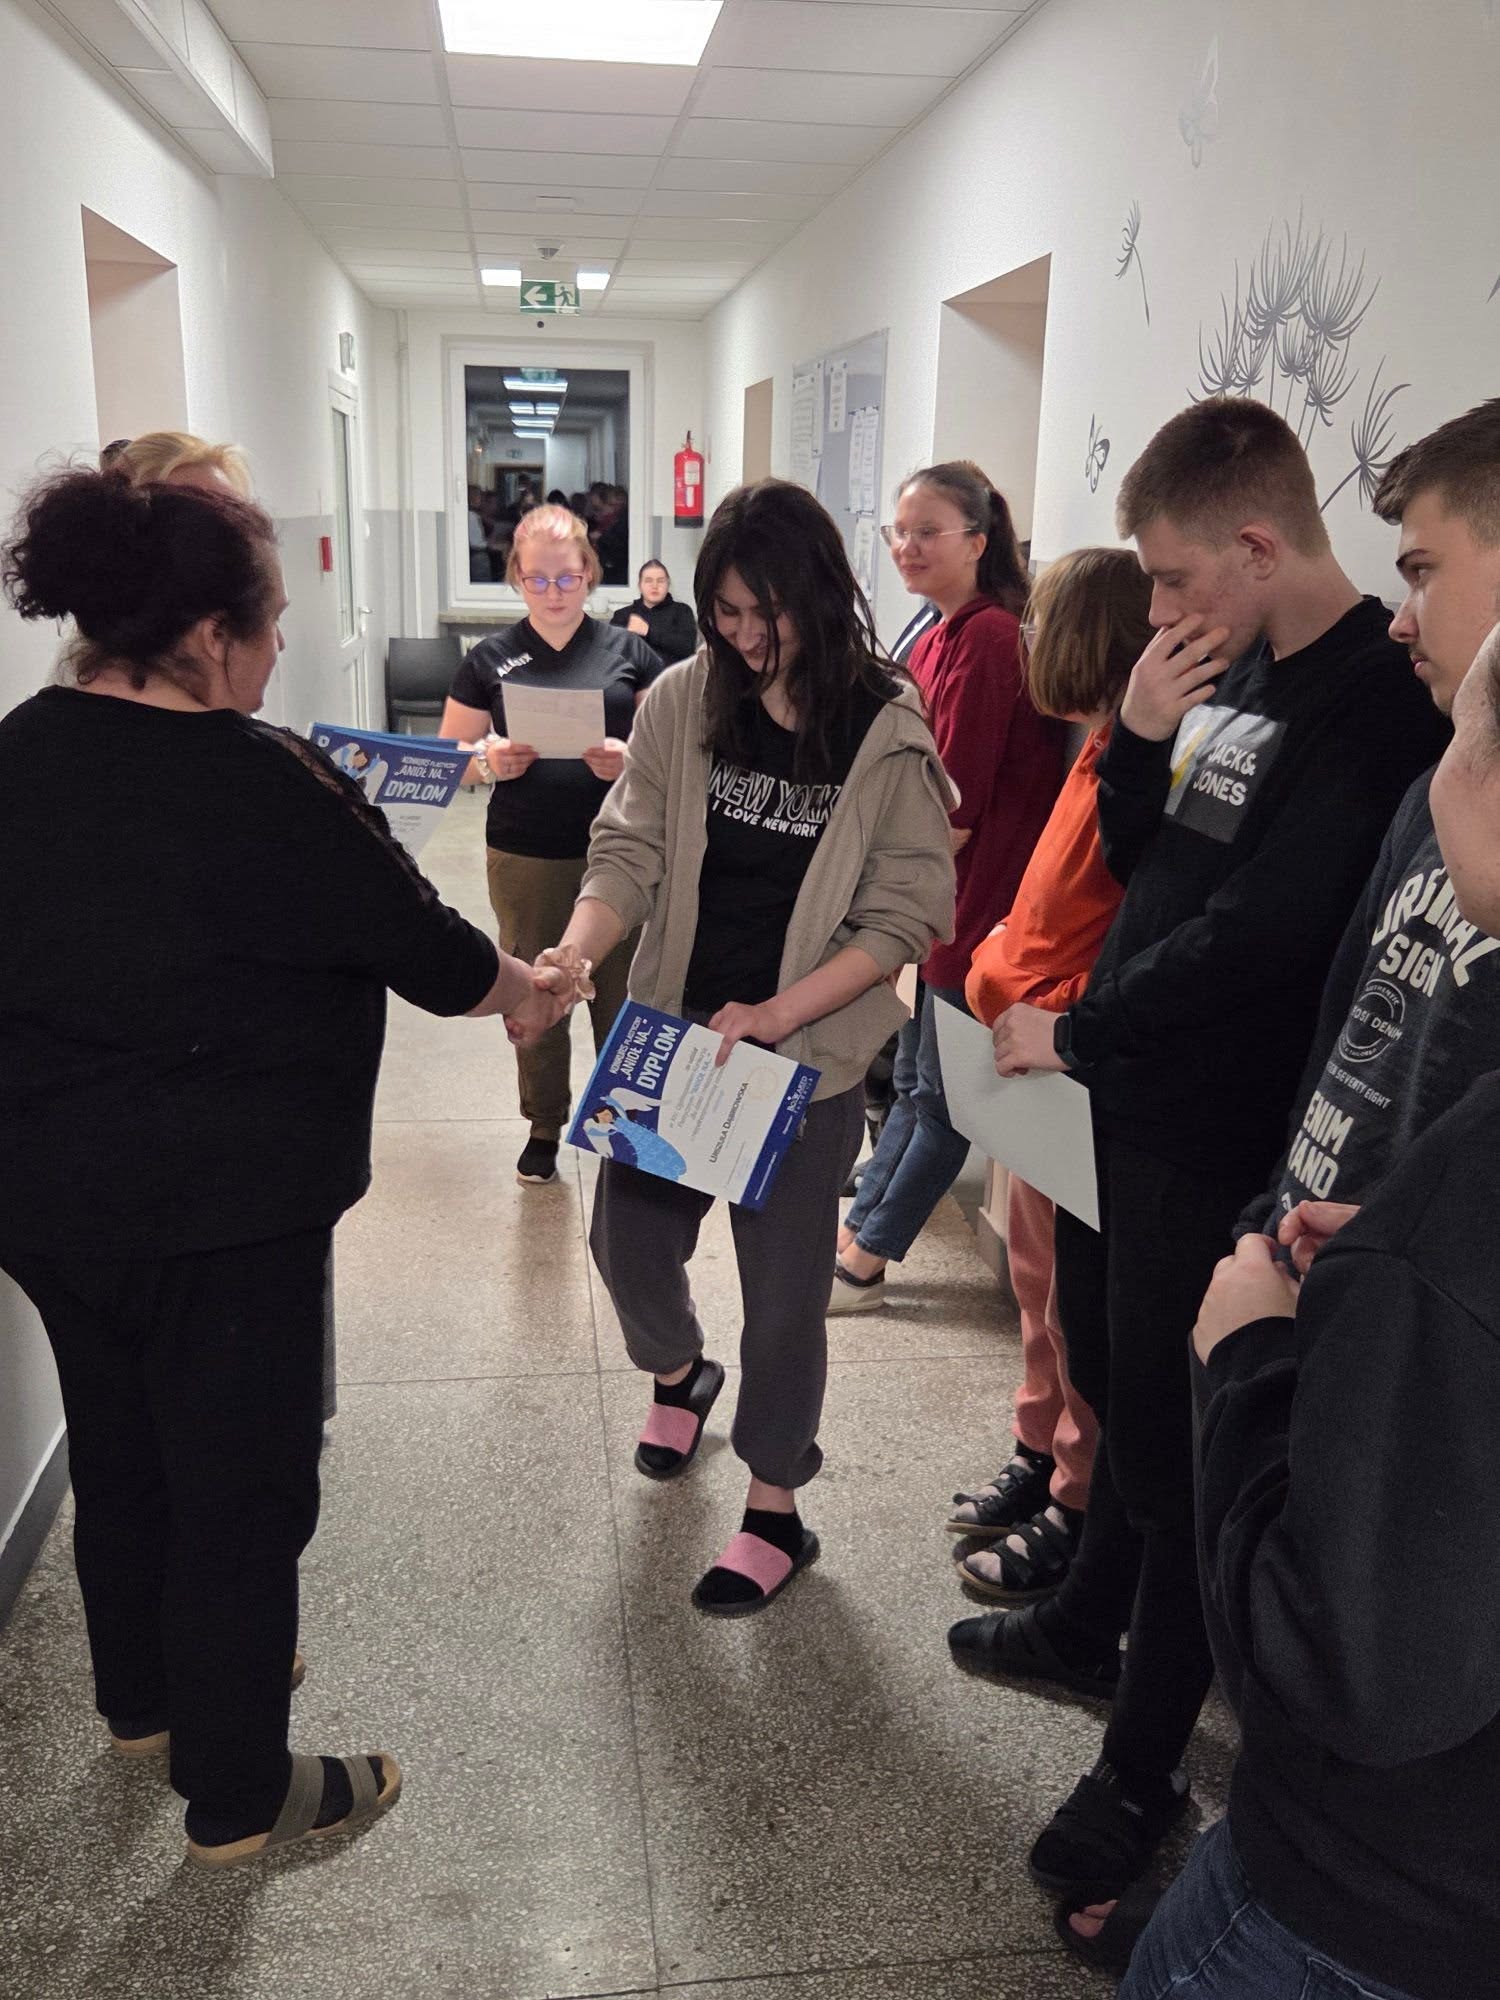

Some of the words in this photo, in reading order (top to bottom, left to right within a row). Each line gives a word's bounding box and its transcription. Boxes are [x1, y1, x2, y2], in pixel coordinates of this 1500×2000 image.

[384, 780, 448, 802] DYPLOM
[709, 762, 775, 813] NEW
[774, 780, 842, 825] YORK
[1193, 769, 1247, 806] JONES
[712, 800, 720, 811] I
[723, 804, 761, 825] LOVE
[762, 817, 790, 834] NEW
[789, 822, 818, 838] YORK
[1370, 1017, 1403, 1041] DENIM
[636, 1024, 681, 1090] DYPLOM
[1336, 1068, 1367, 1094] SEVENTY
[1364, 1088, 1392, 1109] EIGHT
